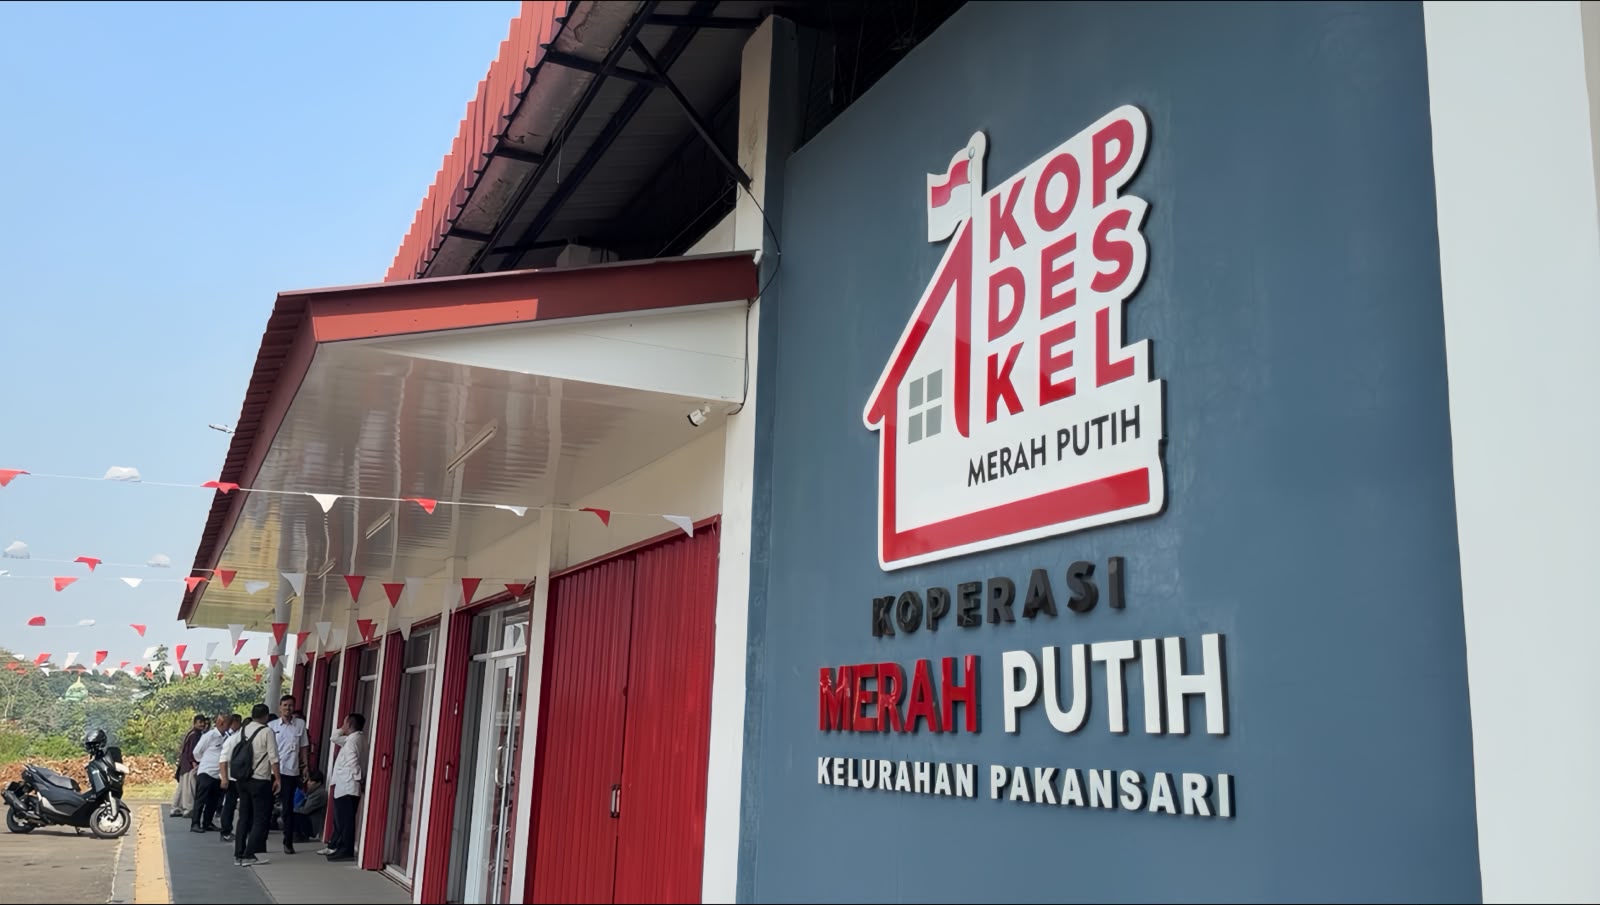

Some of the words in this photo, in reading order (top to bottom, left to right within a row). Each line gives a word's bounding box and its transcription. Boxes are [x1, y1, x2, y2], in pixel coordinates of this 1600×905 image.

[989, 119, 1134, 263] KOP
[988, 209, 1134, 342] DES
[986, 307, 1135, 424] KEL
[968, 435, 1046, 487] MERAH
[1057, 404, 1141, 461] PUTIH
[872, 556, 1125, 637] KOPERASI
[819, 655, 979, 733] MERAH
[1002, 633, 1227, 734] PUTIH
[817, 756, 976, 798] KELURAHAN
[990, 765, 1234, 817] PAKANSARI
